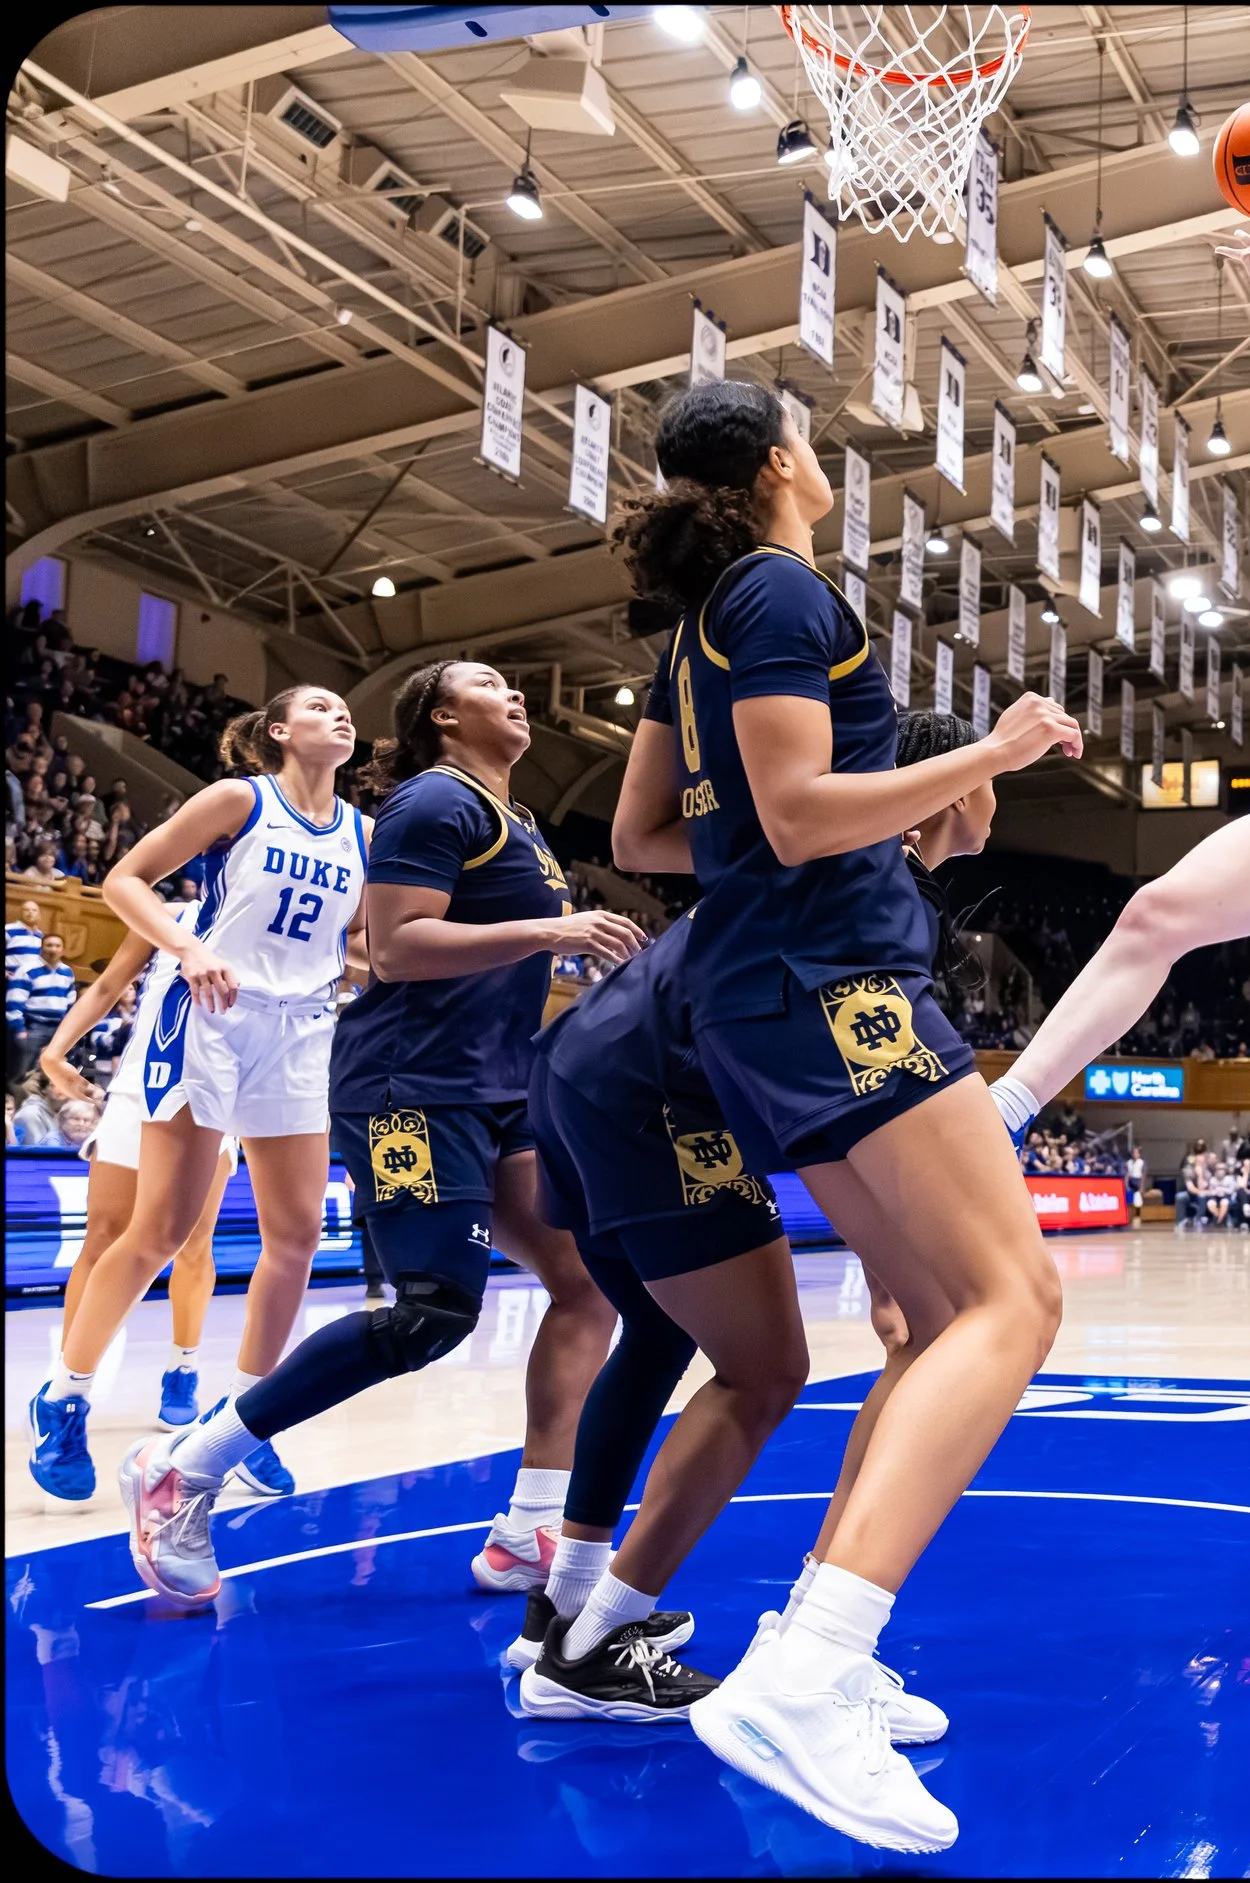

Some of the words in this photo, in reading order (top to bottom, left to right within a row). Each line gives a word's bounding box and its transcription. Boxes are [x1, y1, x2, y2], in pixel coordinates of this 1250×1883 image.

[678, 656, 700, 773] 8
[263, 846, 351, 894] DUKE
[267, 887, 324, 942] 12
[146, 1061, 171, 1089] D
[1131, 1070, 1166, 1086] North
[1131, 1083, 1180, 1098] Carolina
